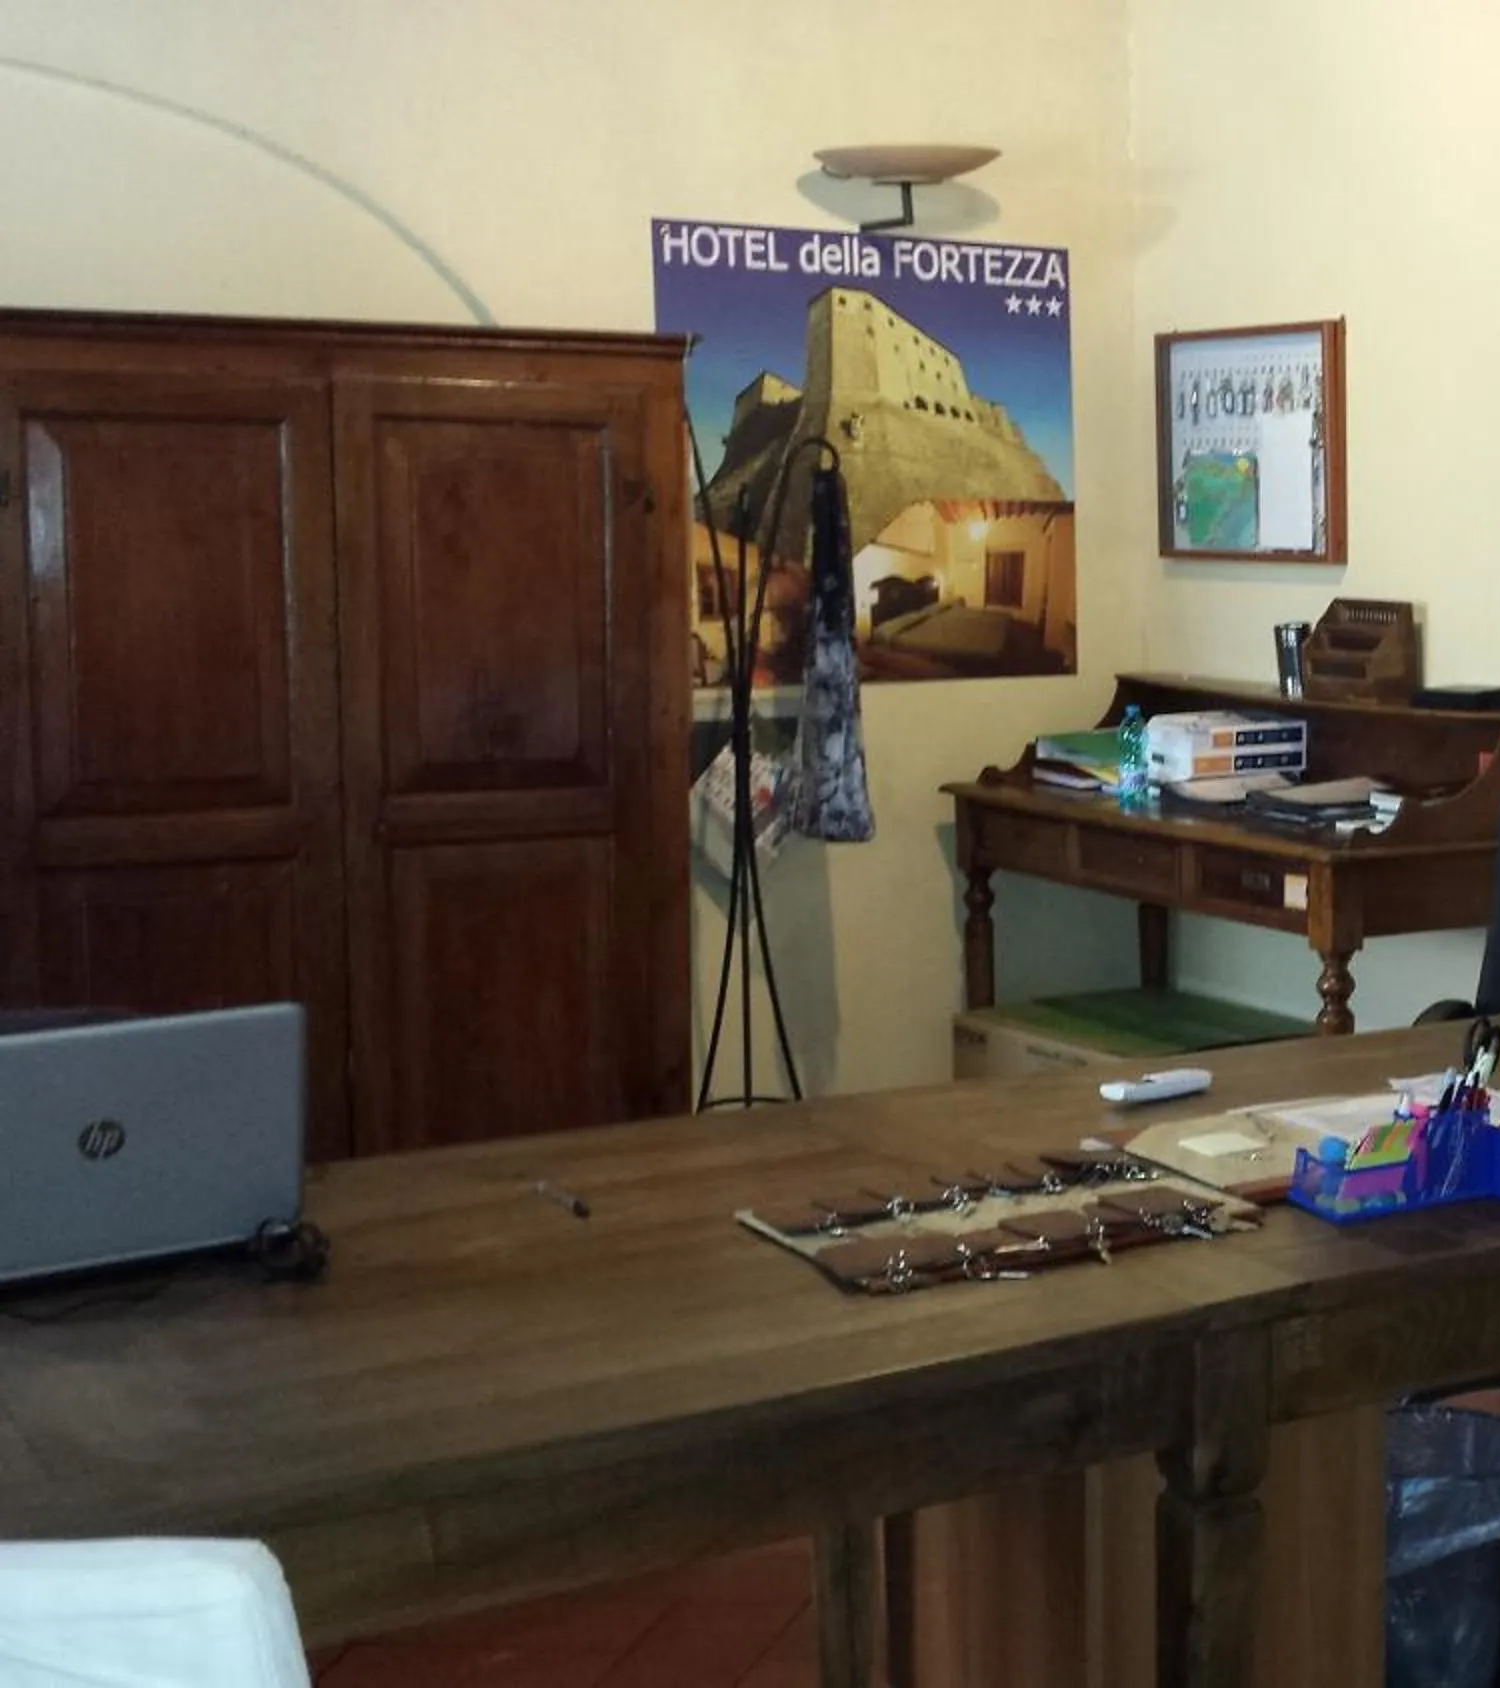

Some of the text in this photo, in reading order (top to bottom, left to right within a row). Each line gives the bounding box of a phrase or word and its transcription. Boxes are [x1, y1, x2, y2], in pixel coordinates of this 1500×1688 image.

[661, 223, 1065, 290] HOTEL della FORTEZZA
[81, 1119, 123, 1159] hp
